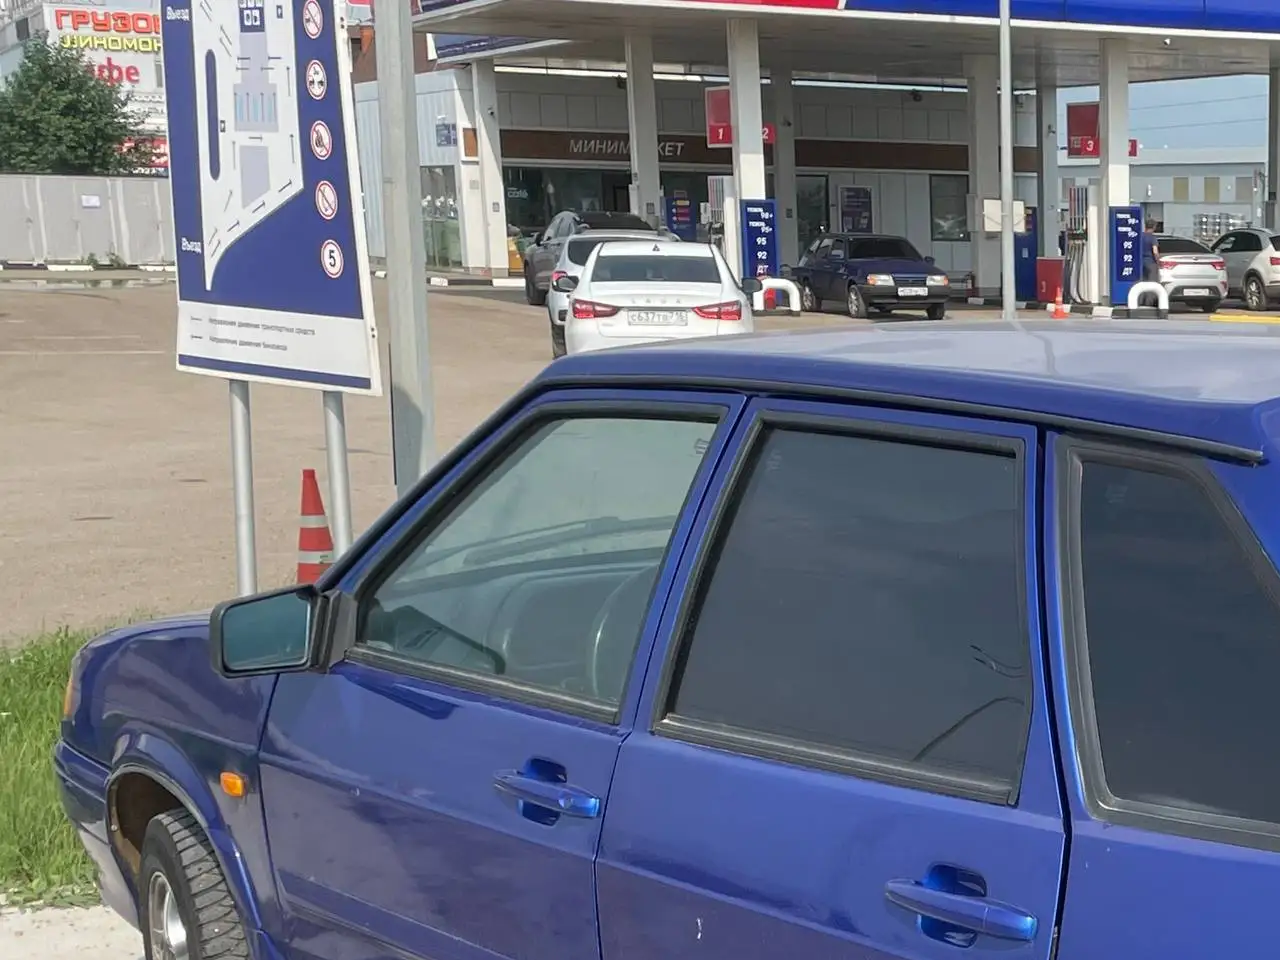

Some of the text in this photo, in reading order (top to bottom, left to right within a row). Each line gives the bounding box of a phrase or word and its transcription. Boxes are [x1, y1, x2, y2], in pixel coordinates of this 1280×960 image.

[717, 127, 724, 140] 1
[569, 139, 685, 156] МИНИМКЕТ
[1086, 140, 1095, 152] 3
[756, 237, 767, 246] 95
[1123, 241, 1132, 249] 95
[328, 250, 337, 267] 5
[757, 251, 768, 260] 92
[1123, 254, 1133, 262] 92
